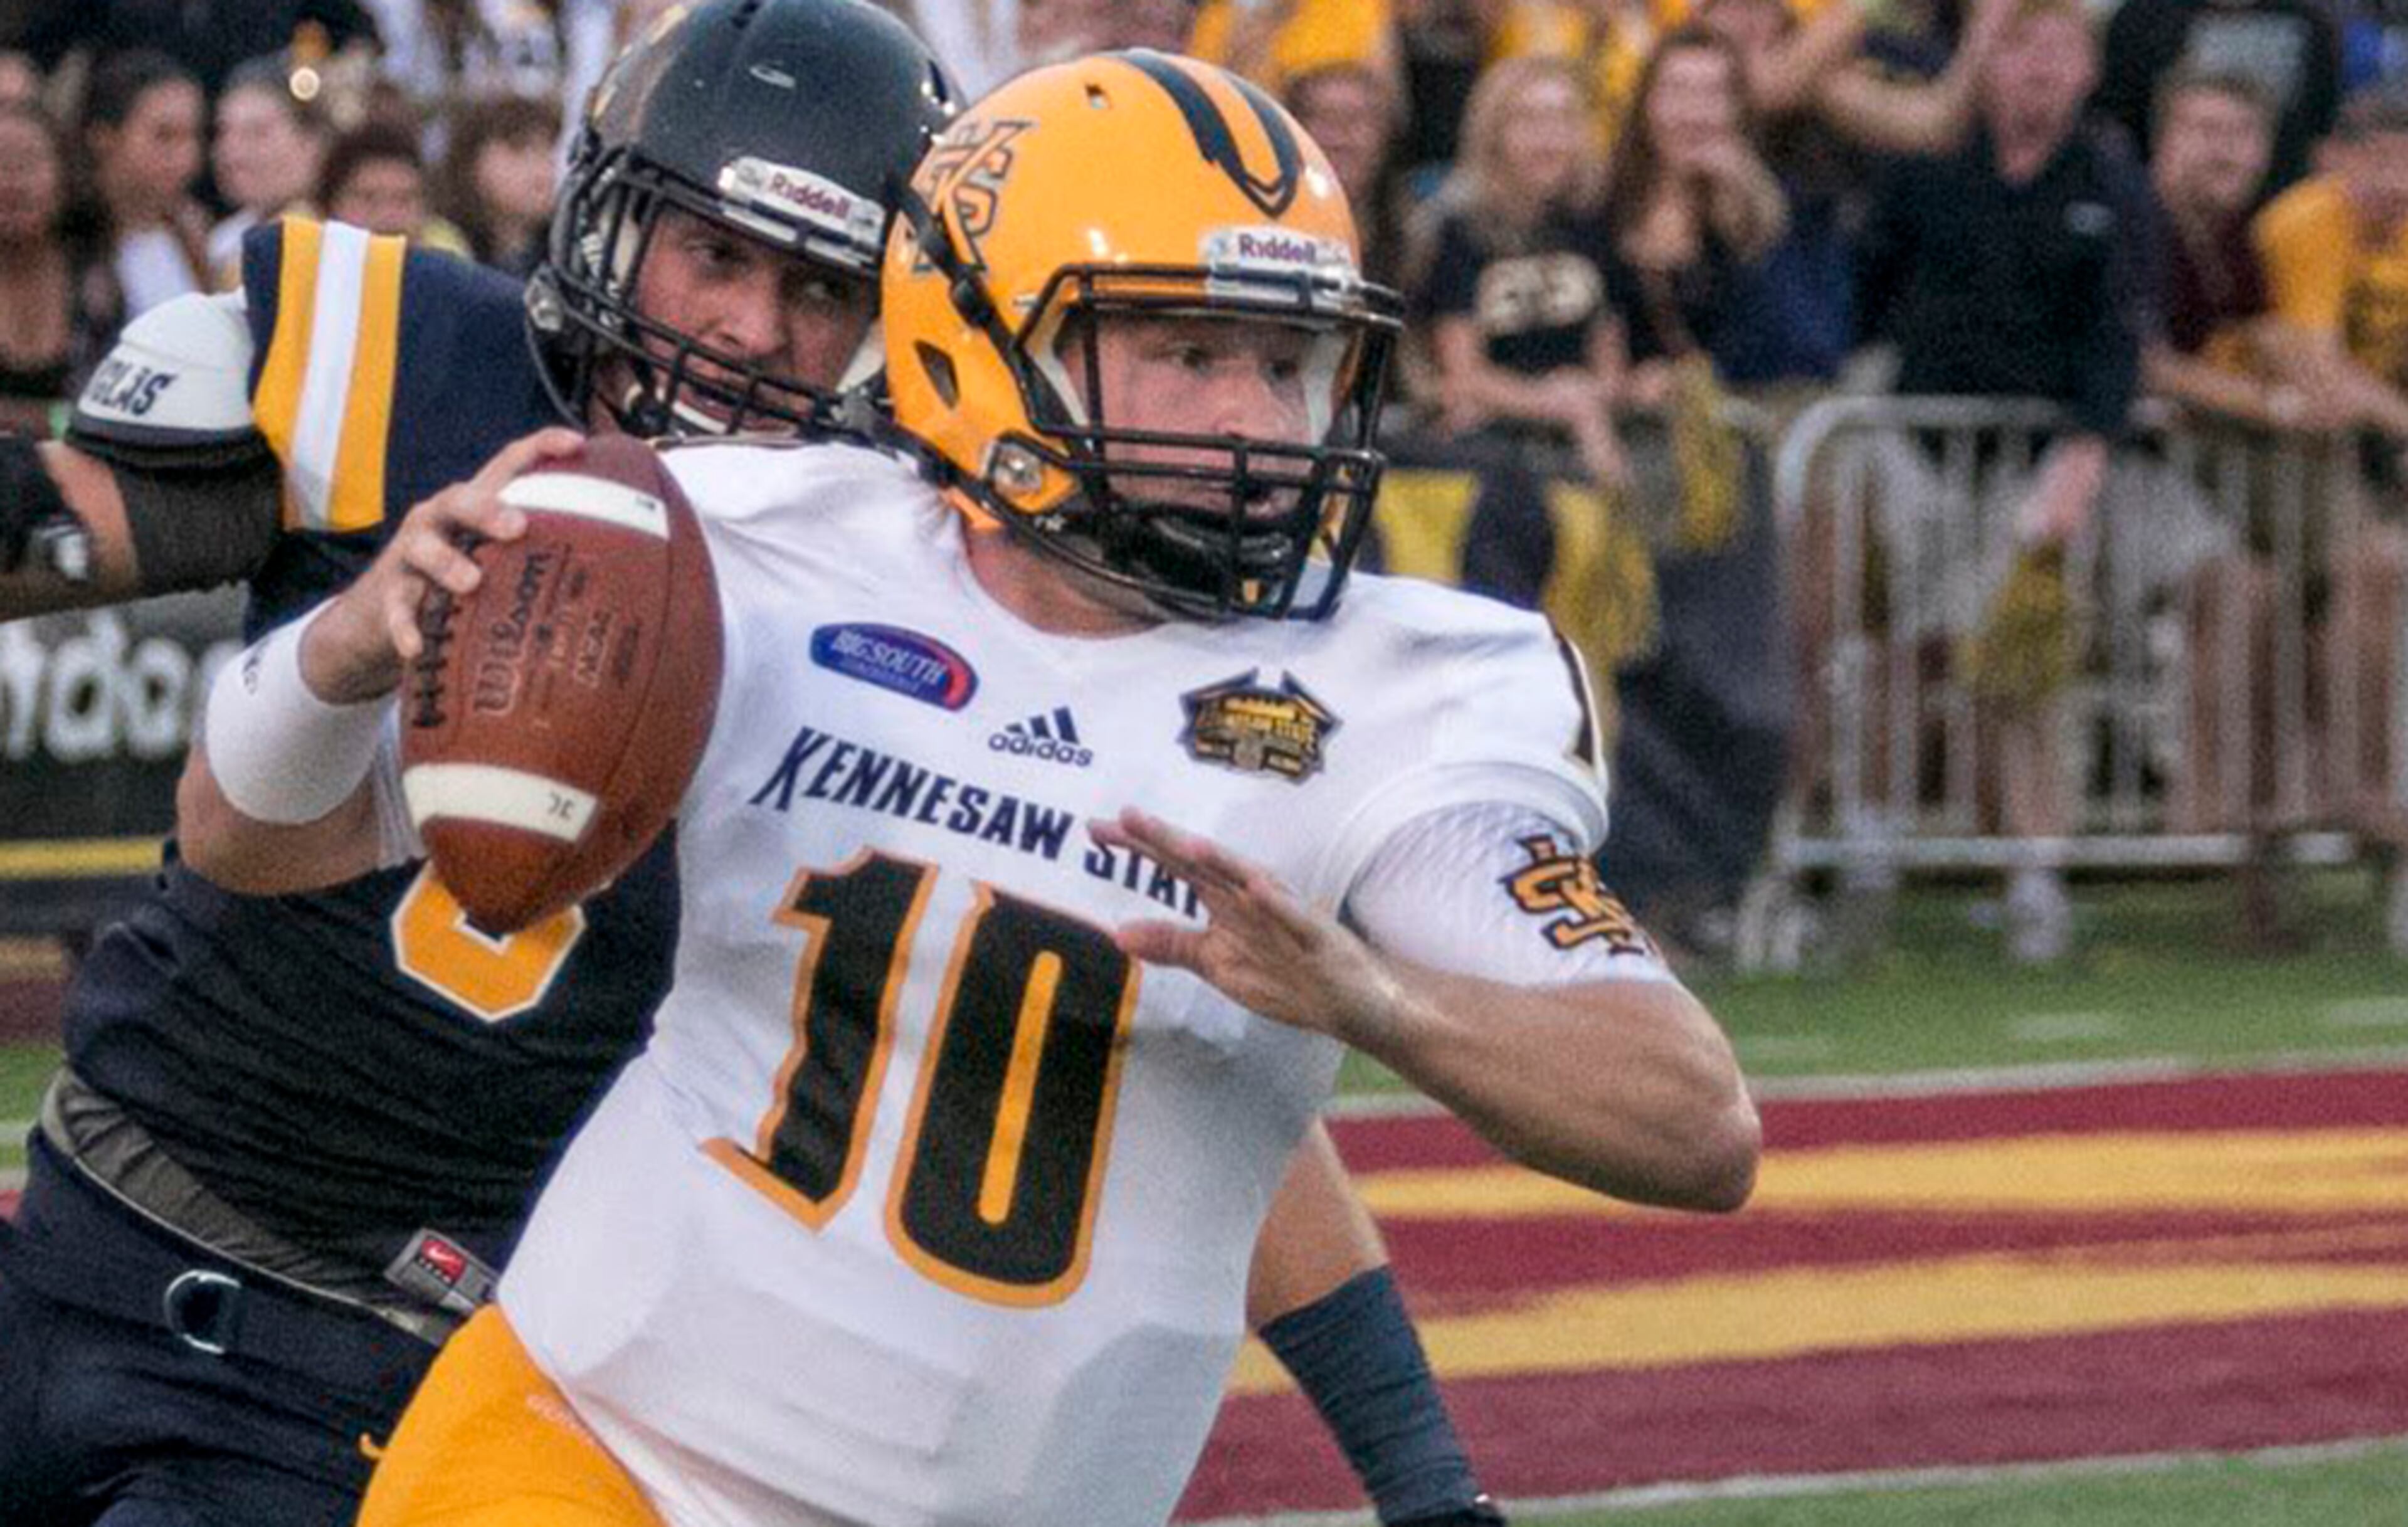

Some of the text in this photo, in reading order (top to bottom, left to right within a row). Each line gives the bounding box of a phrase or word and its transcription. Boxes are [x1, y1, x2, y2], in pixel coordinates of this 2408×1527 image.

[769, 171, 850, 219] Riddell
[1238, 233, 1316, 263] Riddell
[472, 548, 553, 716] Wilson
[748, 726, 1075, 861] KENNESAW
[988, 732, 1094, 767] adidas
[697, 846, 1143, 1309] 10
